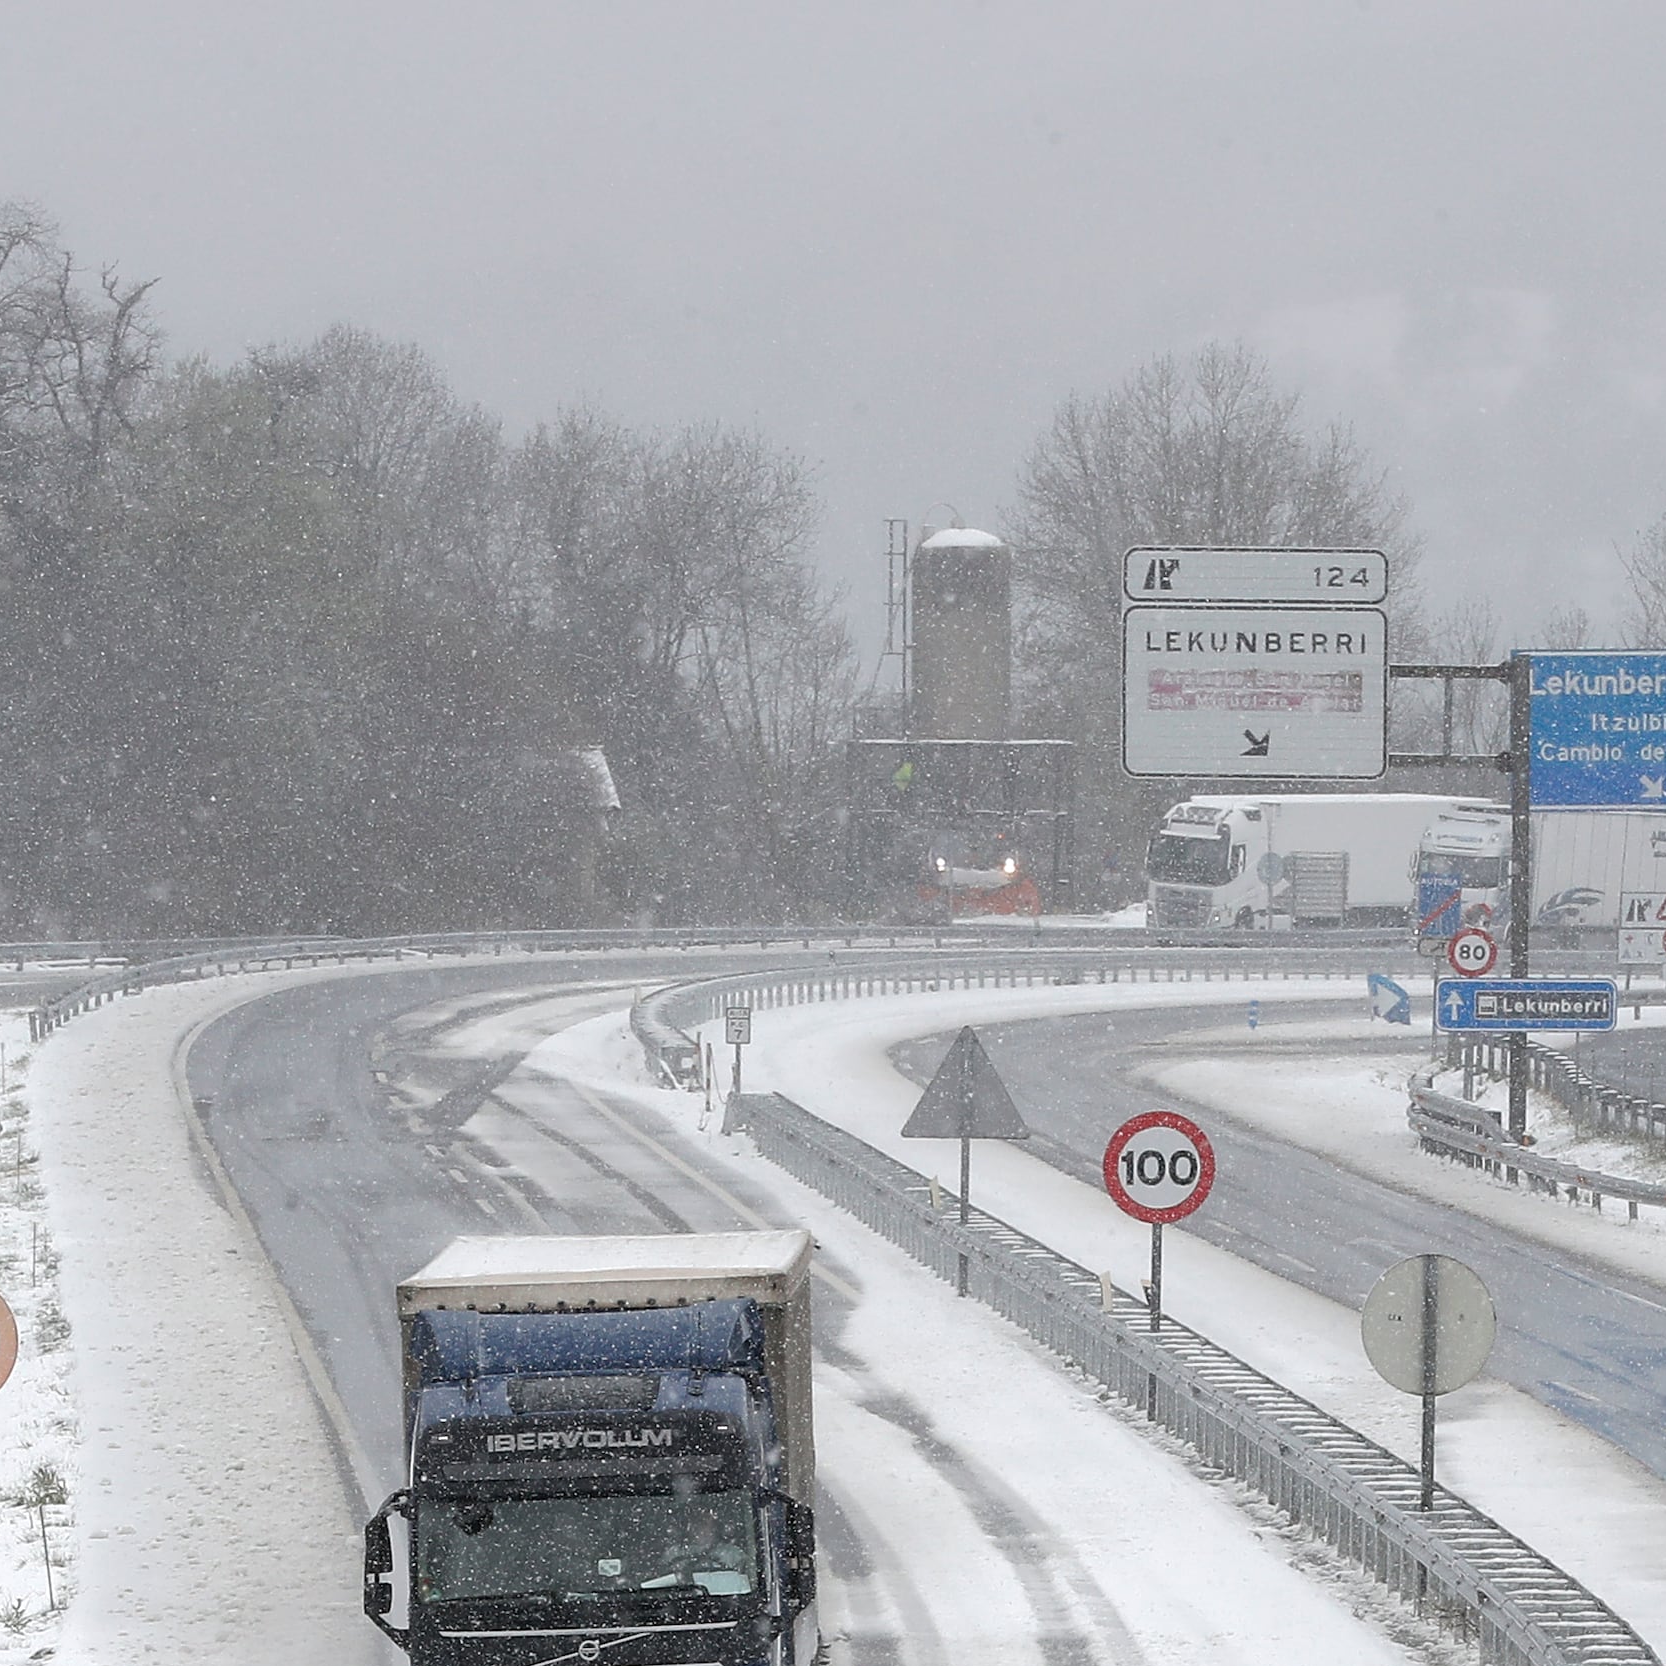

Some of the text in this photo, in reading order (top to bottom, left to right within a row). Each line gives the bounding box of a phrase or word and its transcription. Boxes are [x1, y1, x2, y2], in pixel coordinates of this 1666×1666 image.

[1313, 567, 1370, 588] 124
[1145, 631, 1367, 655] LEKUNBERRI
[1540, 743, 1623, 762] Cambio
[1640, 742, 1666, 762] de
[1459, 944, 1486, 961] 80
[1502, 996, 1608, 1013] Lekunberri
[734, 1029, 743, 1040] 7
[1120, 1150, 1199, 1186] 100
[486, 1428, 673, 1453] IBERVOLUM
